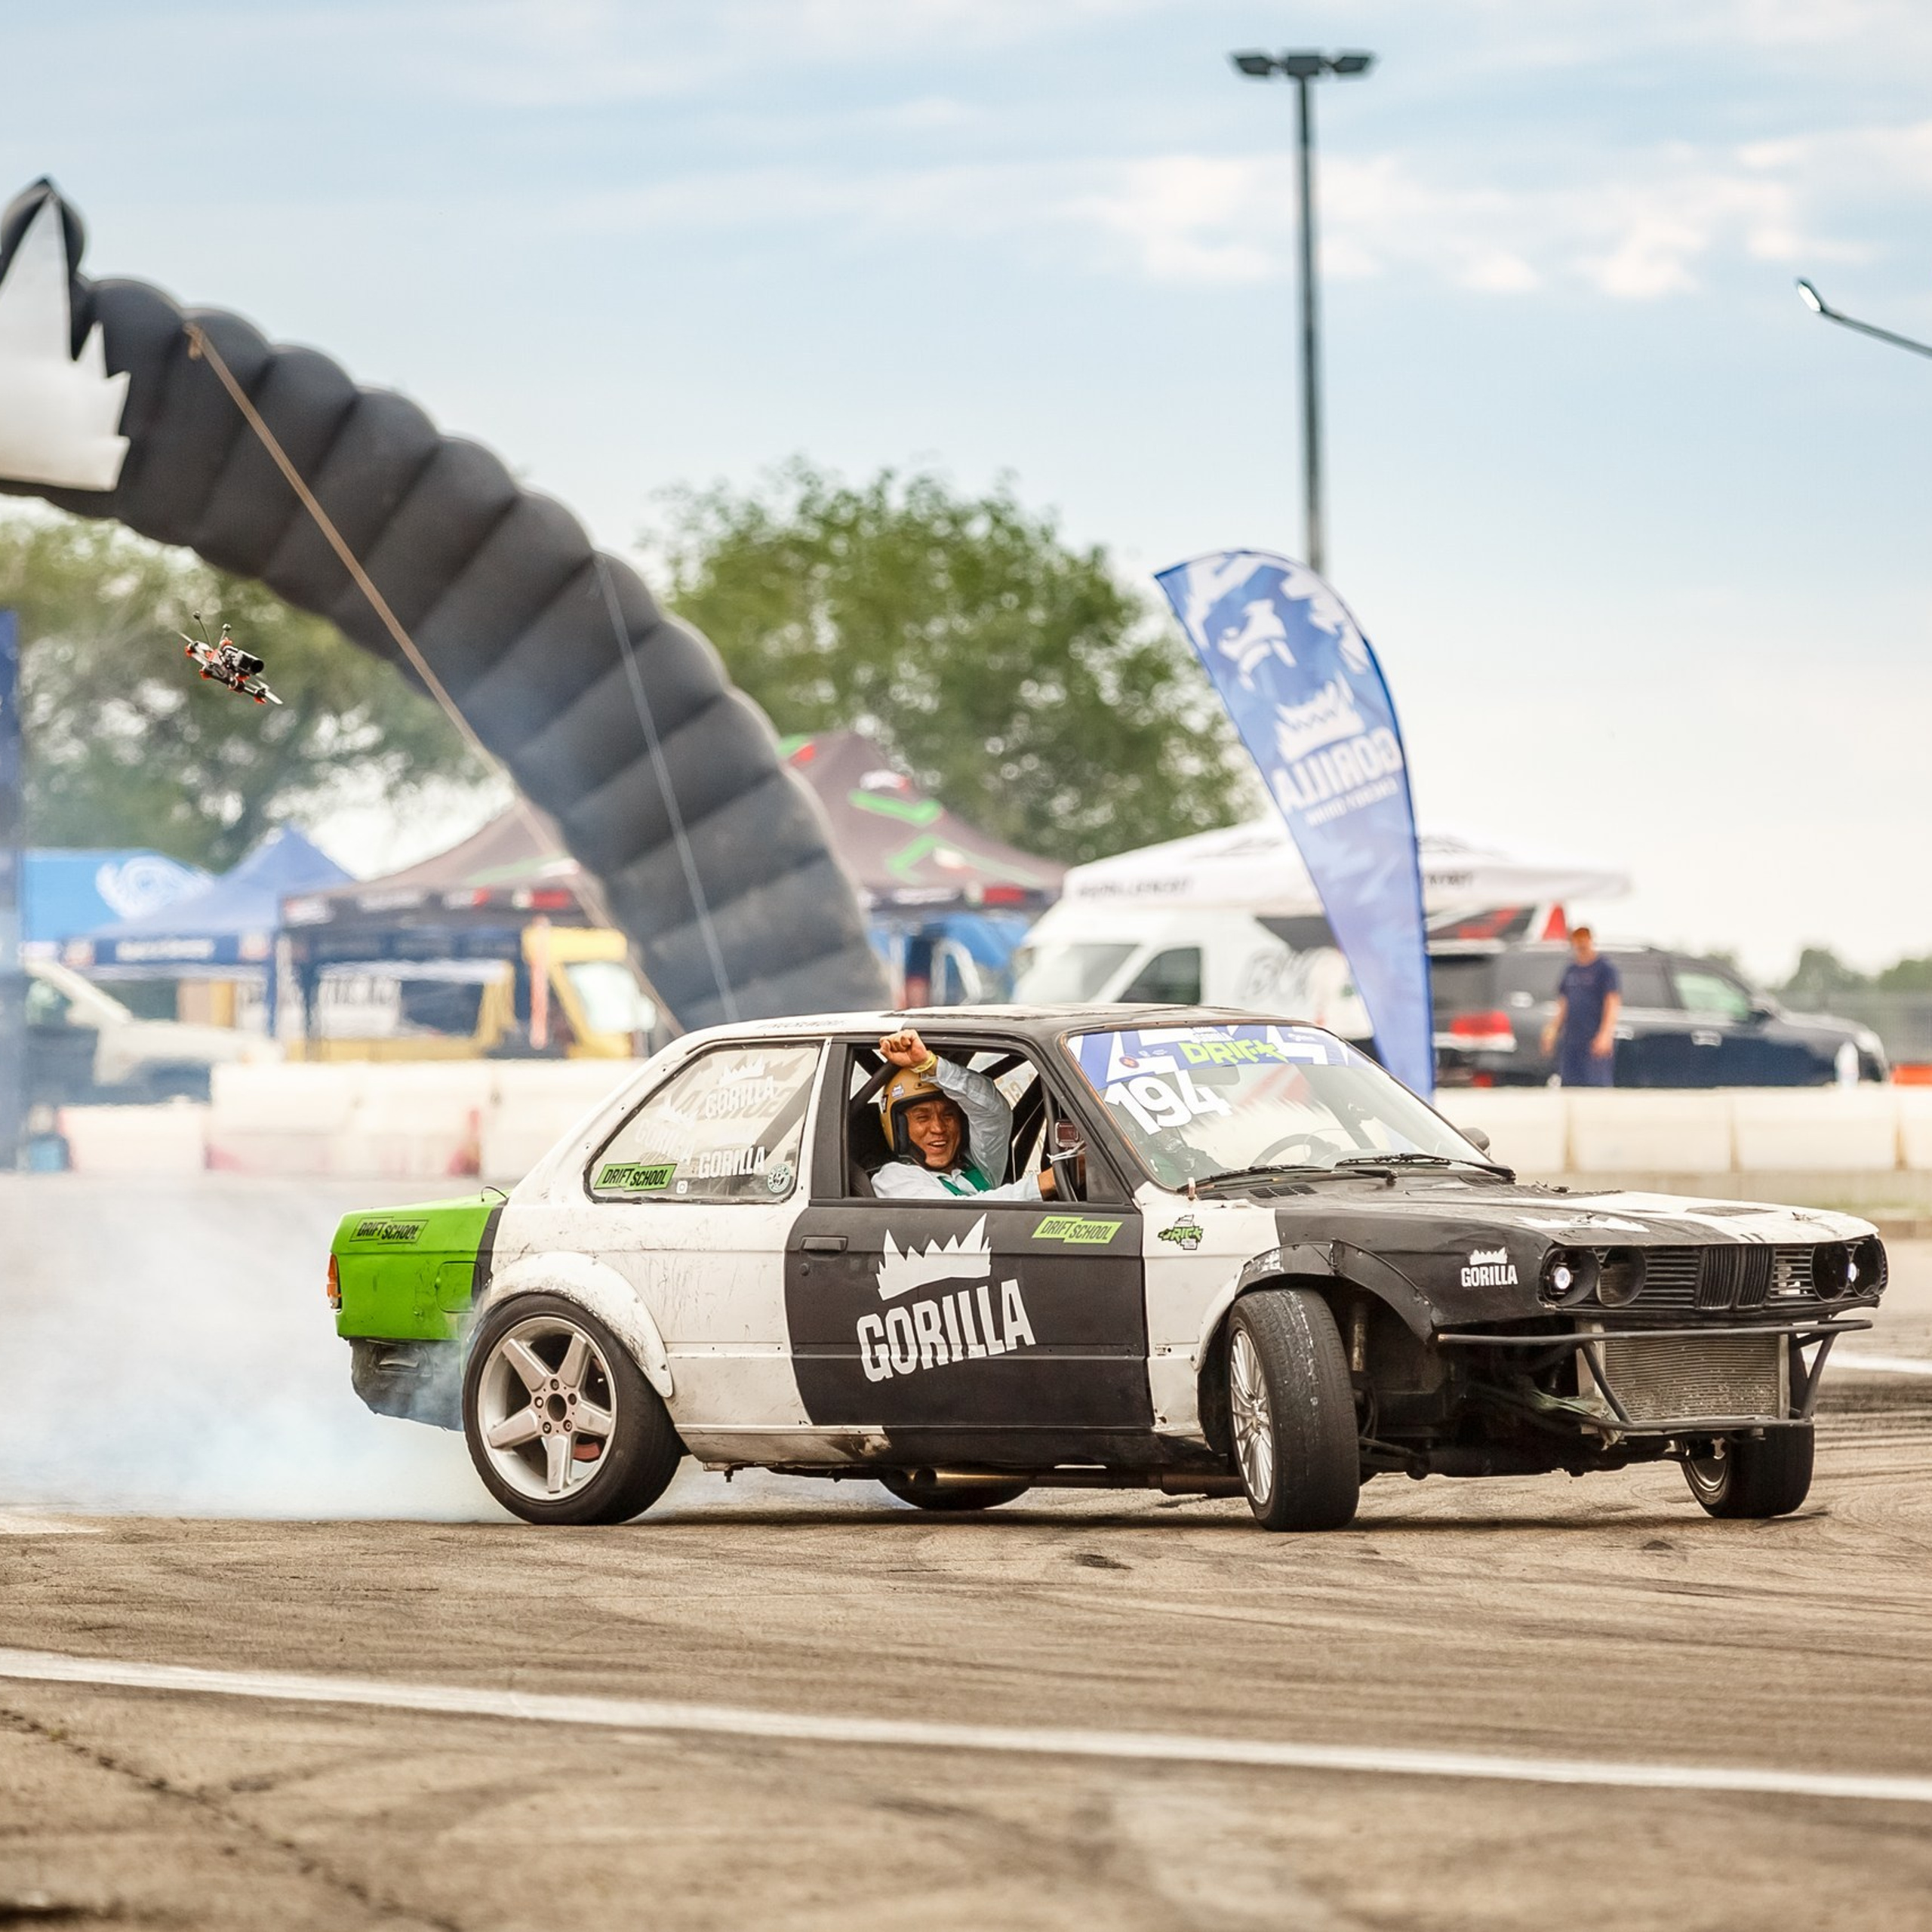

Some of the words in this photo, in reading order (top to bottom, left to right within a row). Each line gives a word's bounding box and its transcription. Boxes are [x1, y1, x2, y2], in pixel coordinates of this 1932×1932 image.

[1178, 1039, 1288, 1064] DRIFT
[705, 1075, 775, 1119] GORILLA
[1104, 1069, 1233, 1135] 194
[699, 1146, 765, 1179] GORILLA
[602, 1168, 635, 1184] DRIFT
[629, 1169, 668, 1186] SCHOOL
[356, 1222, 388, 1237] DRIFT
[381, 1224, 420, 1240] SCHOOL
[1040, 1220, 1077, 1235] DRIFT
[1069, 1224, 1112, 1240] SCHOOL
[1461, 1264, 1518, 1287] GORILLA
[857, 1278, 1036, 1383] GORILLA
